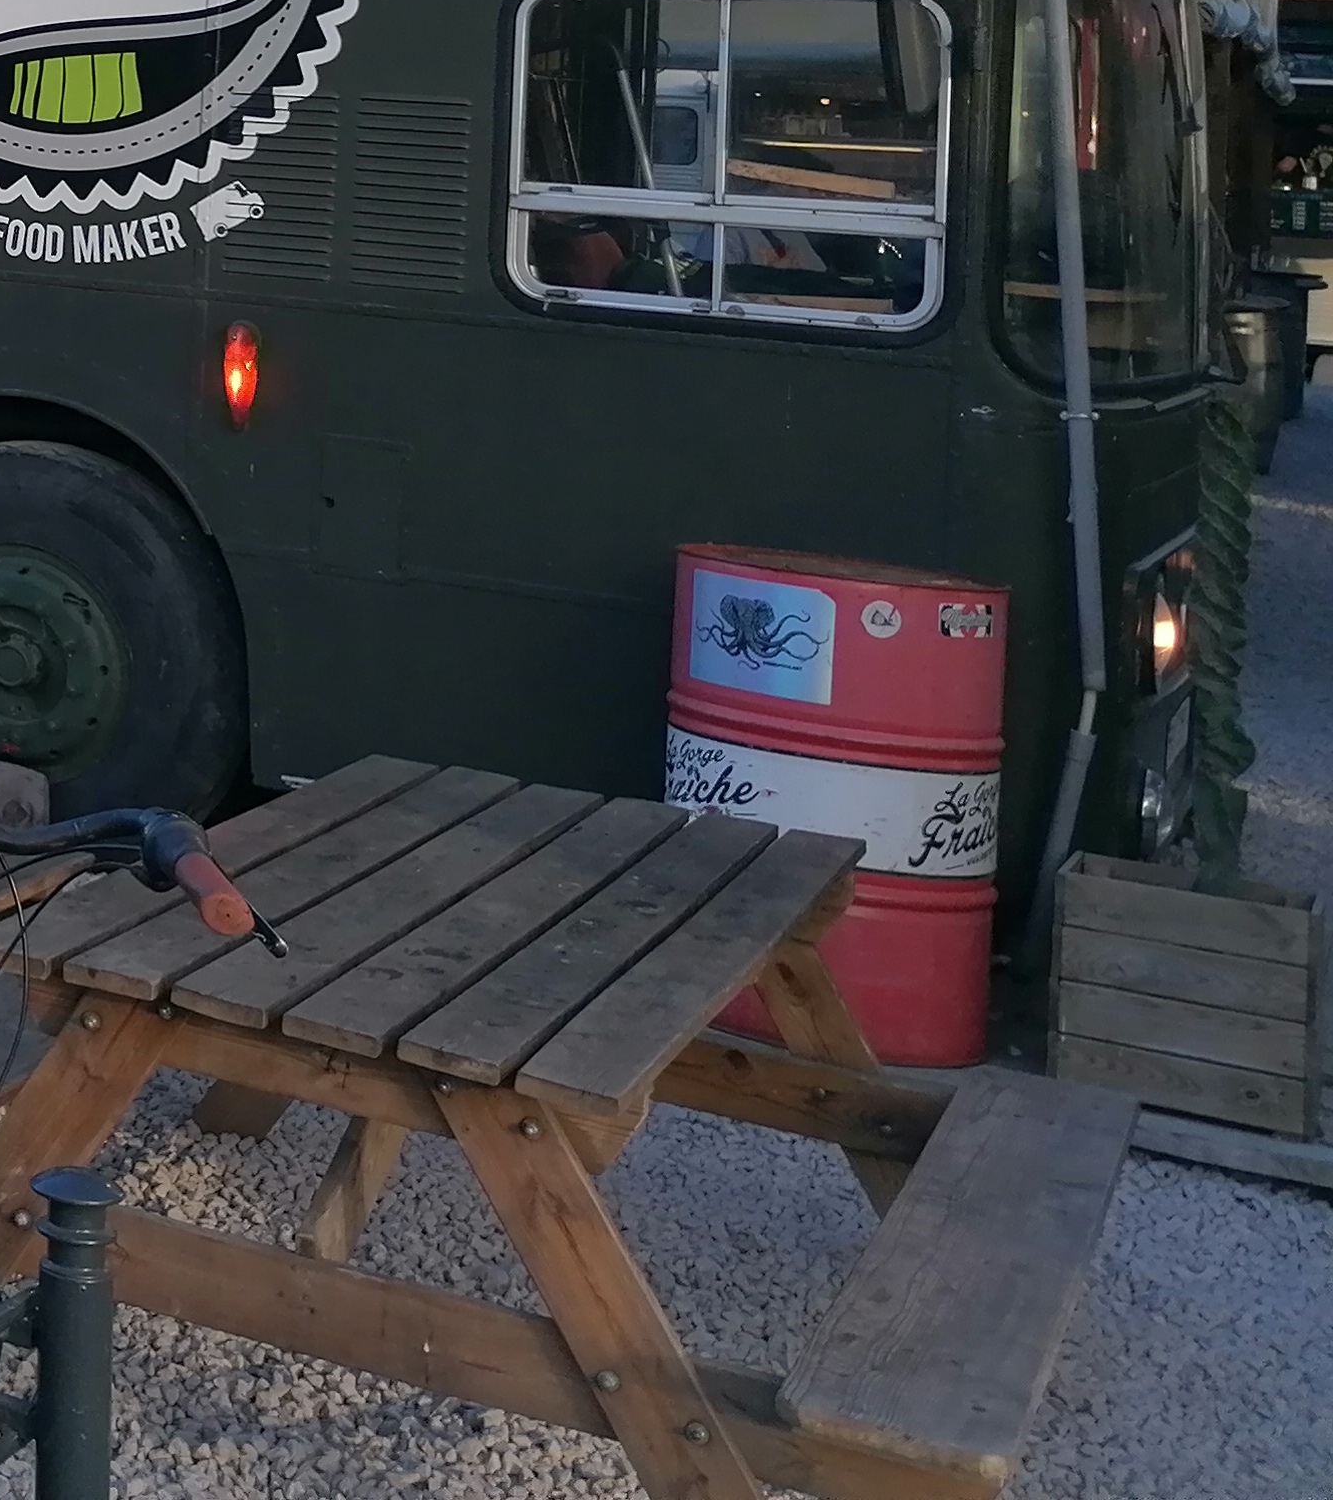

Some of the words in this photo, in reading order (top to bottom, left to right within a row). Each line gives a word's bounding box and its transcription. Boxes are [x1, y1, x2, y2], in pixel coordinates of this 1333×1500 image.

[71, 211, 187, 264] MAKER
[679, 739, 726, 770] Gorge
[934, 781, 970, 826] La
